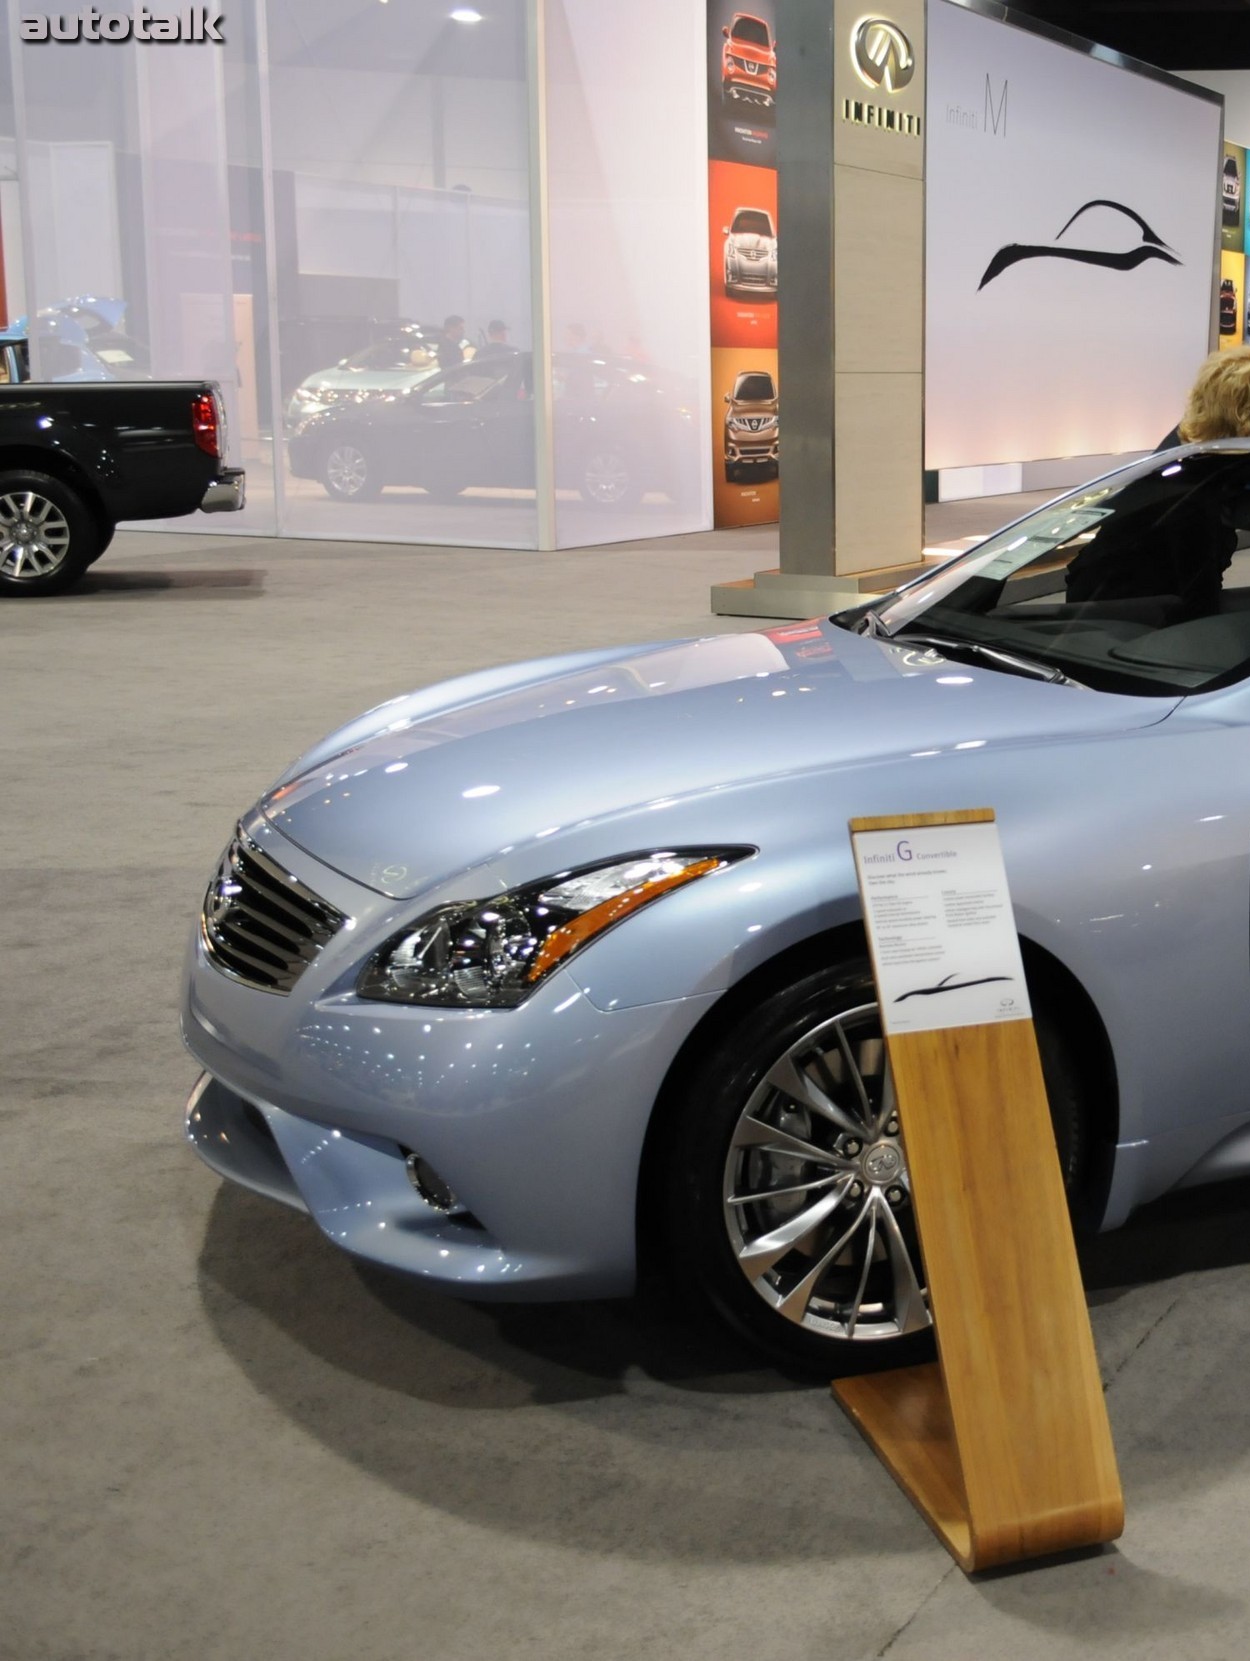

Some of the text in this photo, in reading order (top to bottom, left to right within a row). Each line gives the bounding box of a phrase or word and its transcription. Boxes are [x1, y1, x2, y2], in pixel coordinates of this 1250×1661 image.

[843, 98, 921, 137] INFINITI
[946, 72, 1008, 137] Infiniti M
[863, 840, 957, 865] Infiniti G Convertible
